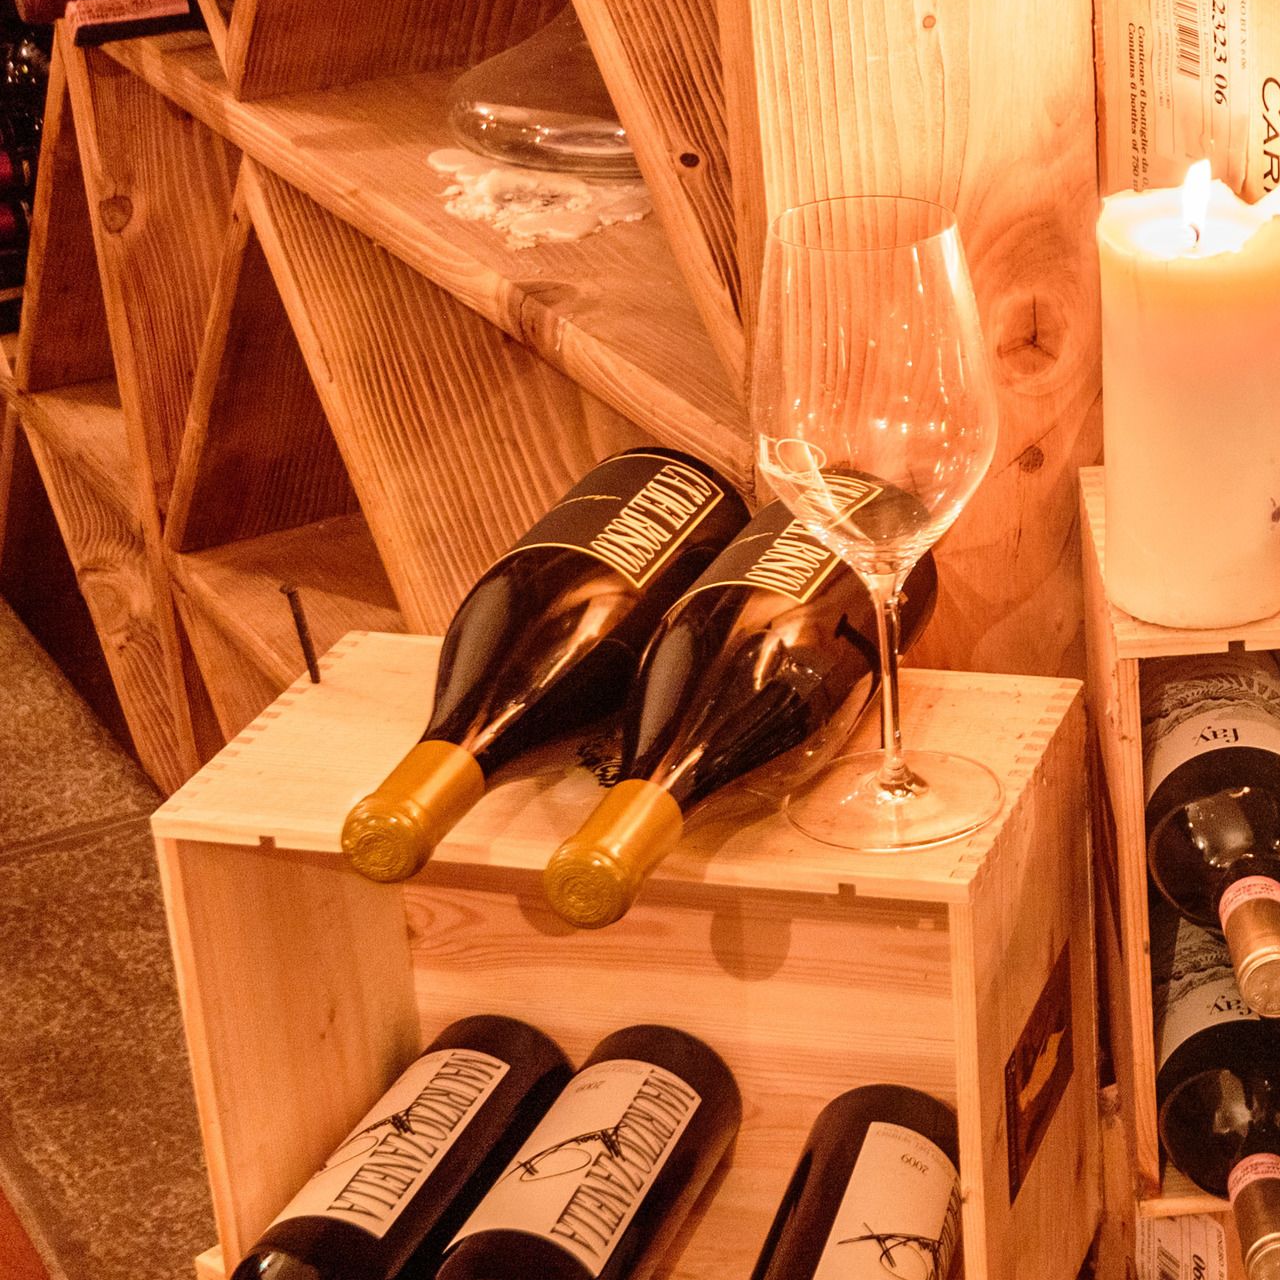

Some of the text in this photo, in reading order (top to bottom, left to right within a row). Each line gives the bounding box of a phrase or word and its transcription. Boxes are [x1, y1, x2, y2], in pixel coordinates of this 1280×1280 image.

[1128, 22, 1137, 79] Contains
[1137, 26, 1147, 87] Contiene
[1130, 92, 1140, 134] bottles
[1212, 73, 1229, 108] 06
[1138, 101, 1150, 155] bottiglie
[631, 481, 698, 531] DEL
[590, 506, 672, 575] BOSCO
[746, 530, 831, 594] BOSCO
[1192, 725, 1240, 747] fay
[327, 1053, 502, 1227] MAURIZIO ZANELLA
[601, 1069, 699, 1178] MAURIZIO
[899, 1152, 930, 1176] 2009
[550, 1152, 648, 1258] ZANELLA
